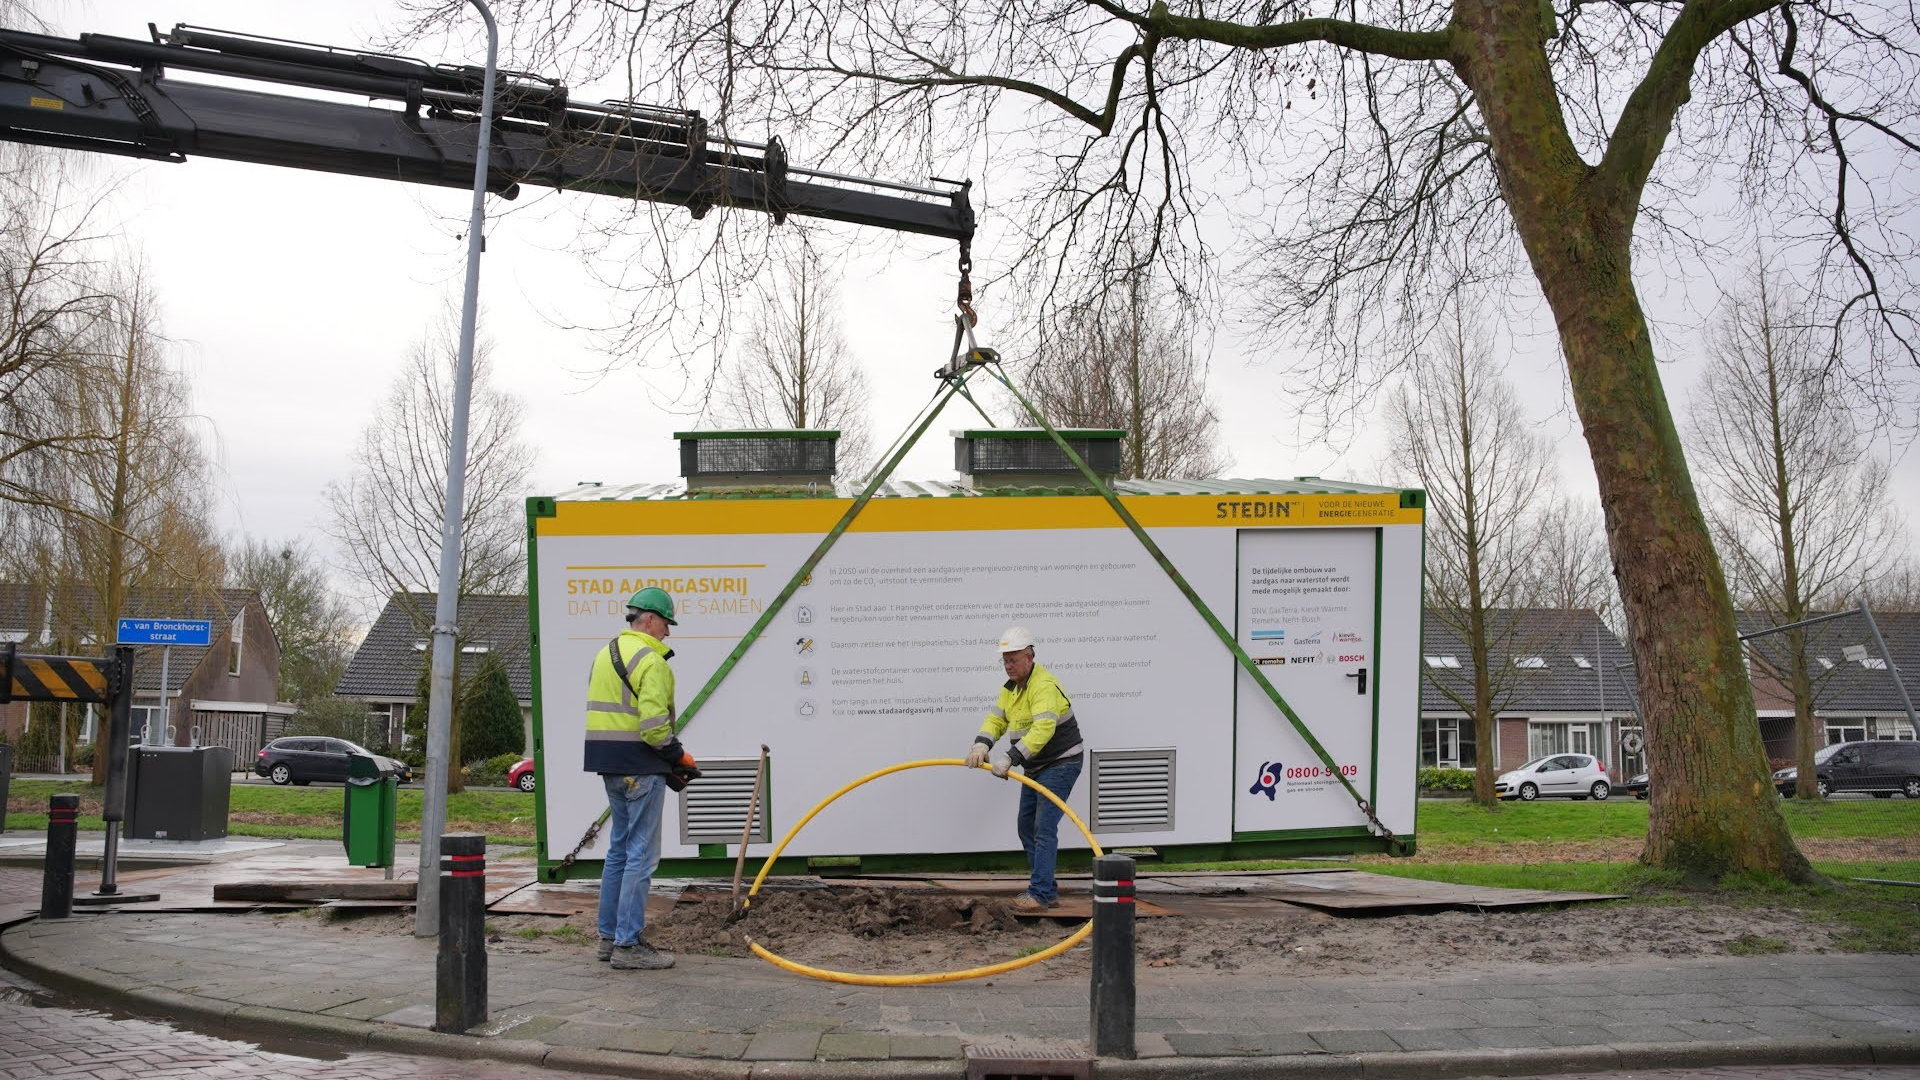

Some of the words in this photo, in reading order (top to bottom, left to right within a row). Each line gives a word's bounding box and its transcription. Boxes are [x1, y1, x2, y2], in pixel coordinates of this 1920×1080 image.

[1354, 500, 1385, 508] NIEUWE
[1216, 501, 1290, 519] STEDIN
[1318, 509, 1396, 518] ENERGIEGENERATIE
[838, 567, 857, 575] 2050
[870, 566, 880, 574] de
[1054, 563, 1088, 572] woningen
[1100, 562, 1136, 572] gebouwen
[1262, 567, 1292, 576] tijdelijke
[854, 577, 862, 585] de
[1252, 578, 1278, 586] aardgas
[567, 578, 614, 595] STAD
[1272, 586, 1301, 595] mogelijk
[1302, 586, 1332, 594] gemaakt
[568, 600, 601, 616] DAT
[698, 598, 762, 614] SAMEN
[855, 604, 872, 612] Stad
[964, 612, 1000, 622] woningen
[1012, 612, 1048, 620] gebouwen
[121, 622, 130, 630] A.
[154, 622, 208, 631] Bronckhorst-
[960, 638, 977, 646] Stad
[1291, 656, 1315, 664] NEFIT
[858, 706, 942, 716] www.stadaardgasvrij.nl
[1286, 765, 1357, 778] 0800-909
